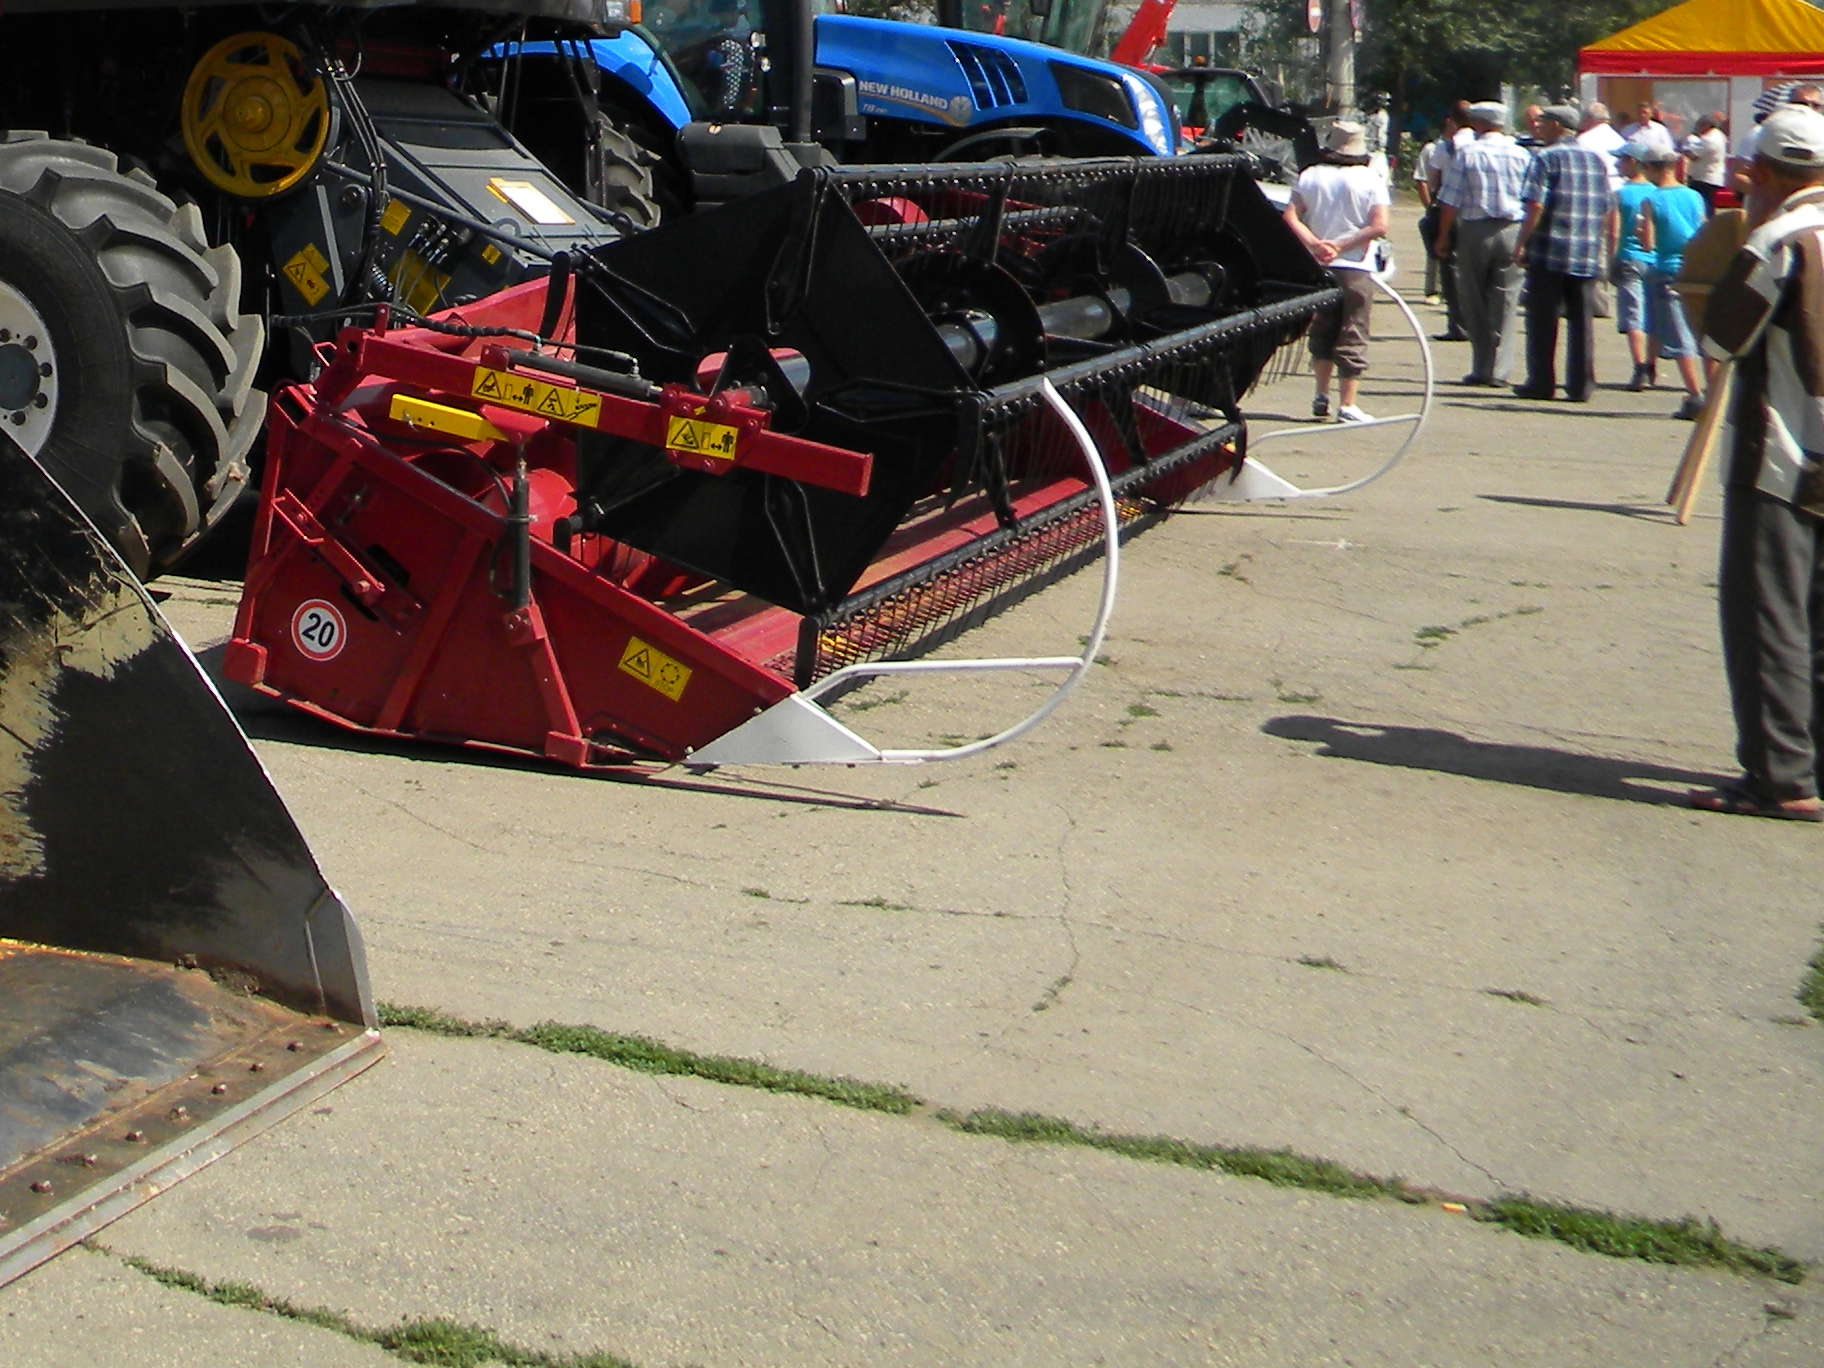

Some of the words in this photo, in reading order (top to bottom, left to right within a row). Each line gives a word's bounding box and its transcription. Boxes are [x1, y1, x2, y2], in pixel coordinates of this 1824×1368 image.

[858, 80, 889, 95] NEW
[890, 85, 948, 110] HOLLAND
[301, 612, 335, 648] 20
